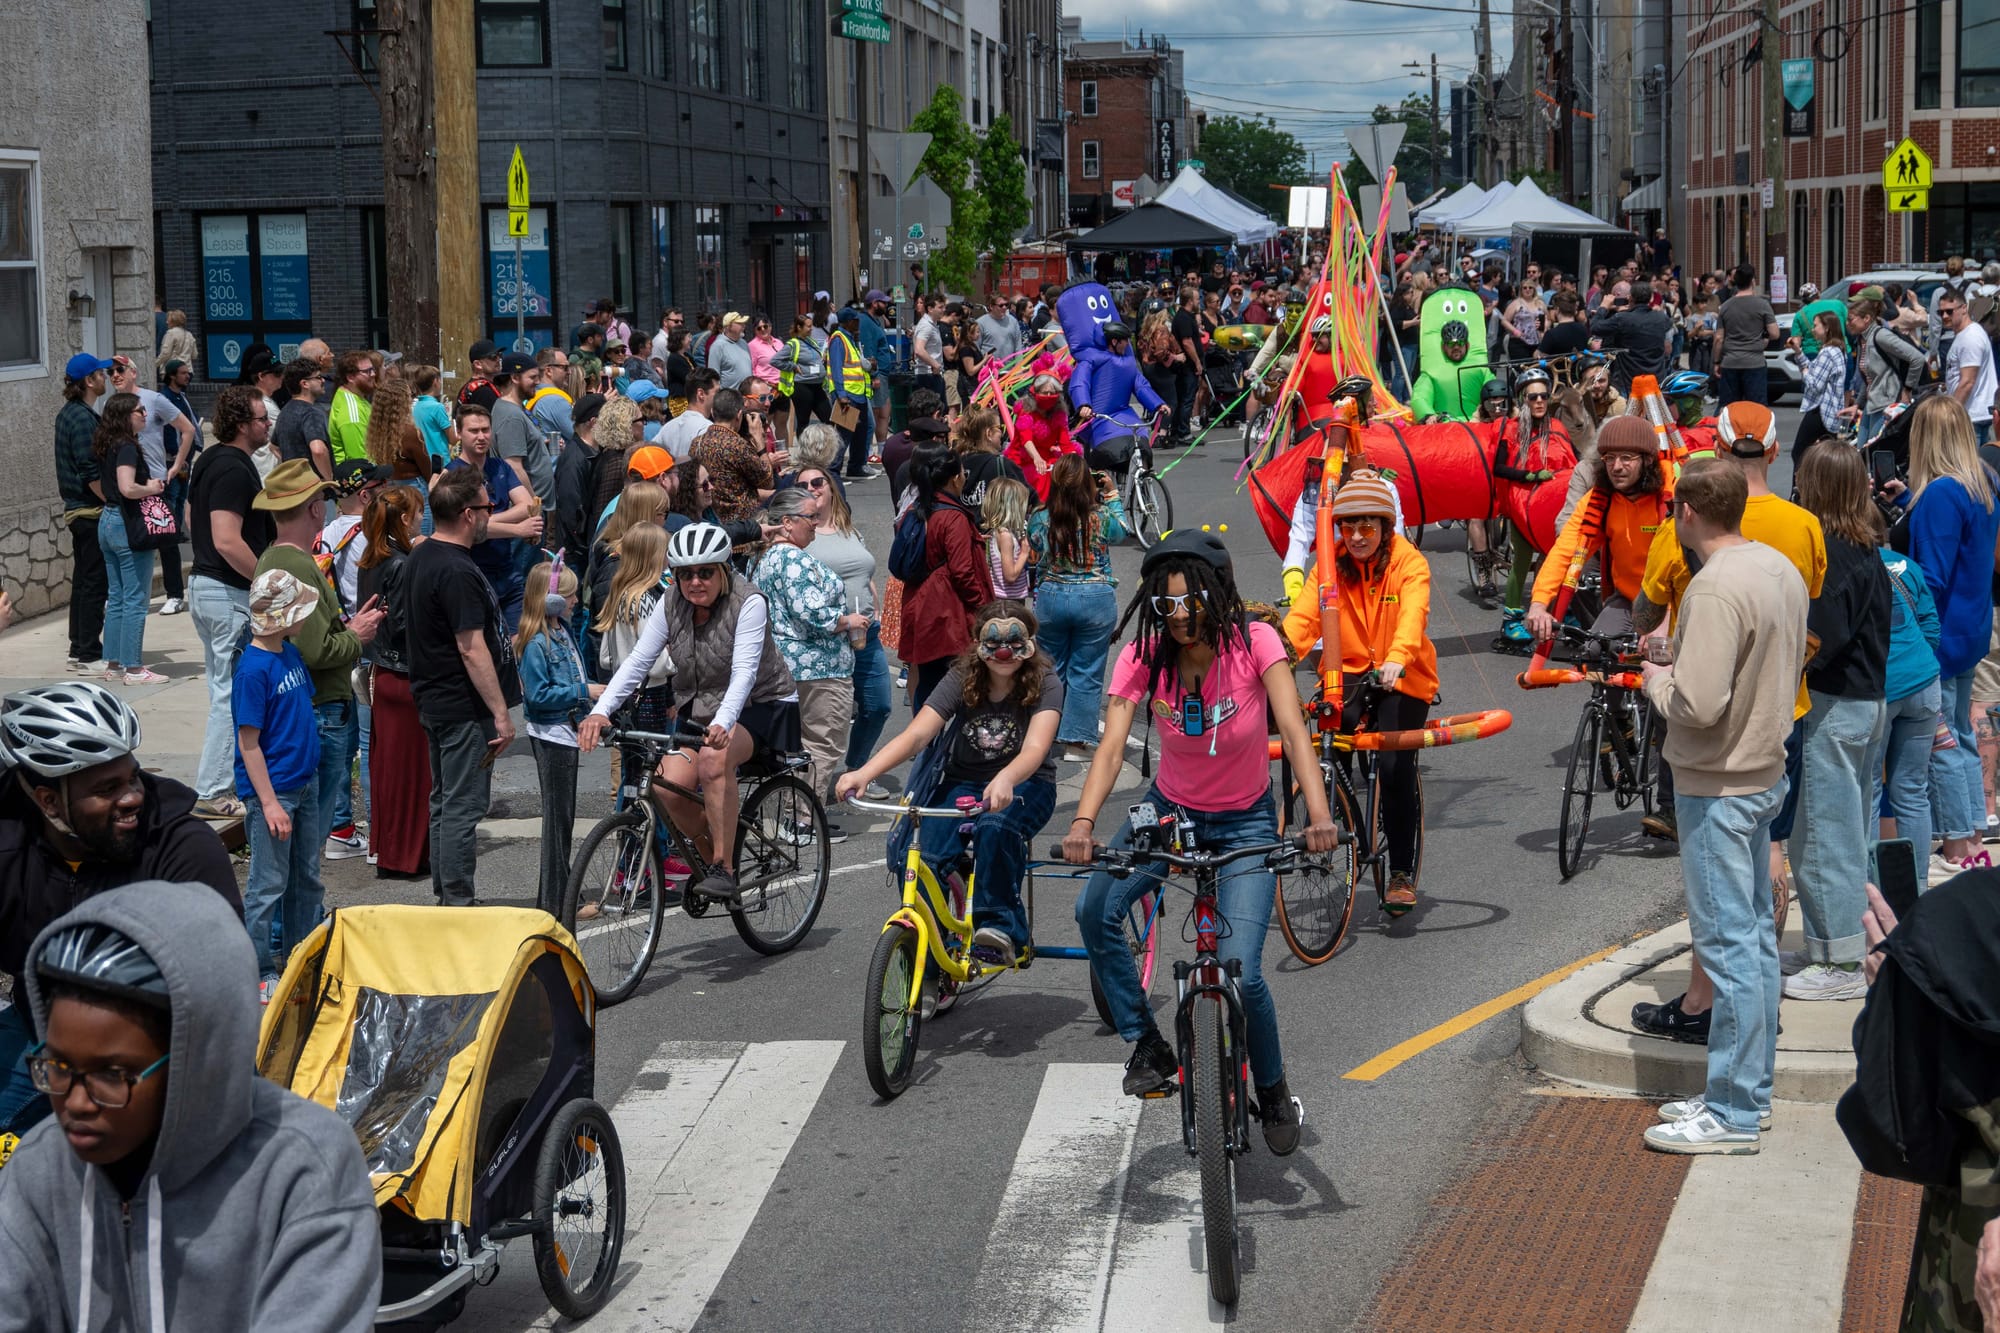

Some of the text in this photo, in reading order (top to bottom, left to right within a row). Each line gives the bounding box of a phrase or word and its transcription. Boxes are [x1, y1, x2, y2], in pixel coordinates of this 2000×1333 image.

[849, 21, 890, 42] Frankford Av
[265, 220, 301, 236] Retail
[205, 236, 244, 251] Lease
[266, 238, 302, 252] Space
[208, 268, 234, 283] 215.
[209, 285, 238, 300] 300.
[210, 302, 244, 317] 9688
